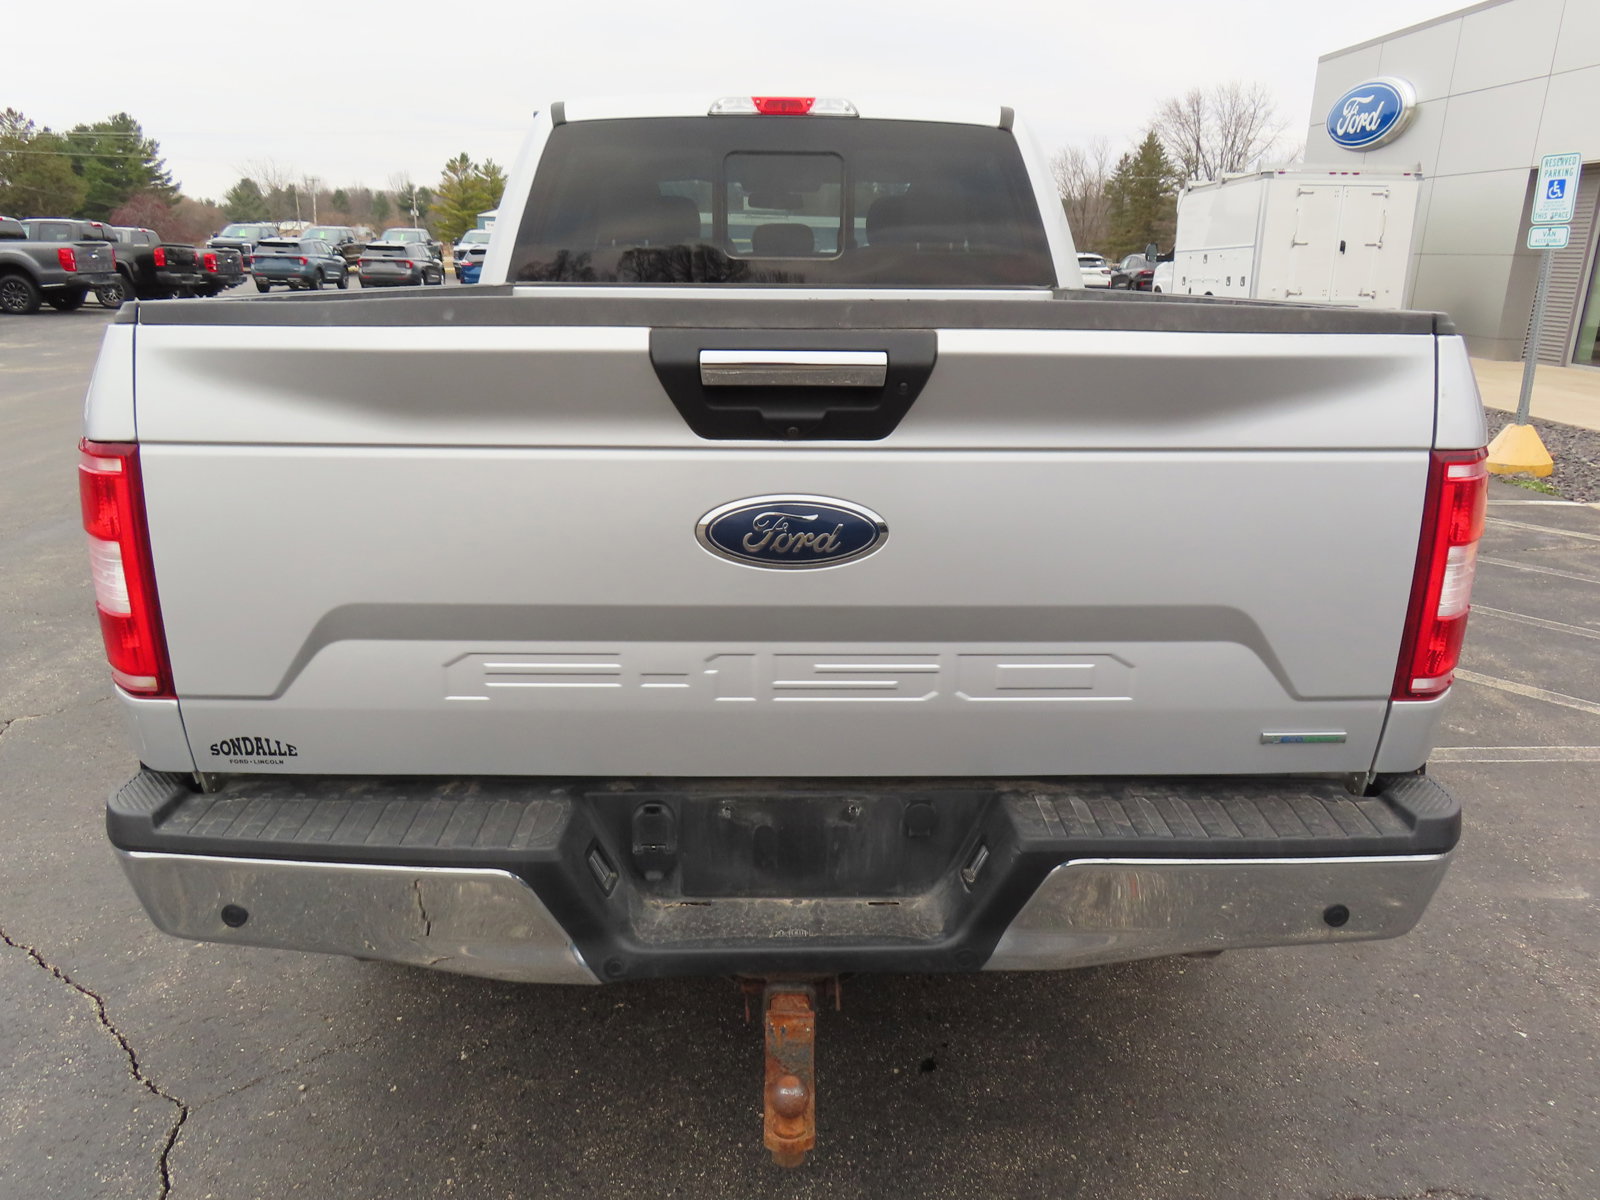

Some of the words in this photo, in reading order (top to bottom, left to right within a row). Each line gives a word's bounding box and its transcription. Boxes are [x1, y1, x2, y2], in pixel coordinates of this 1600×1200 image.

[1336, 94, 1385, 136] Ford
[1544, 156, 1577, 168] RESERVED
[1544, 168, 1574, 178] PARKING
[742, 511, 843, 553] Ford
[443, 652, 1135, 702] F-150
[210, 736, 298, 757] SONDALLE
